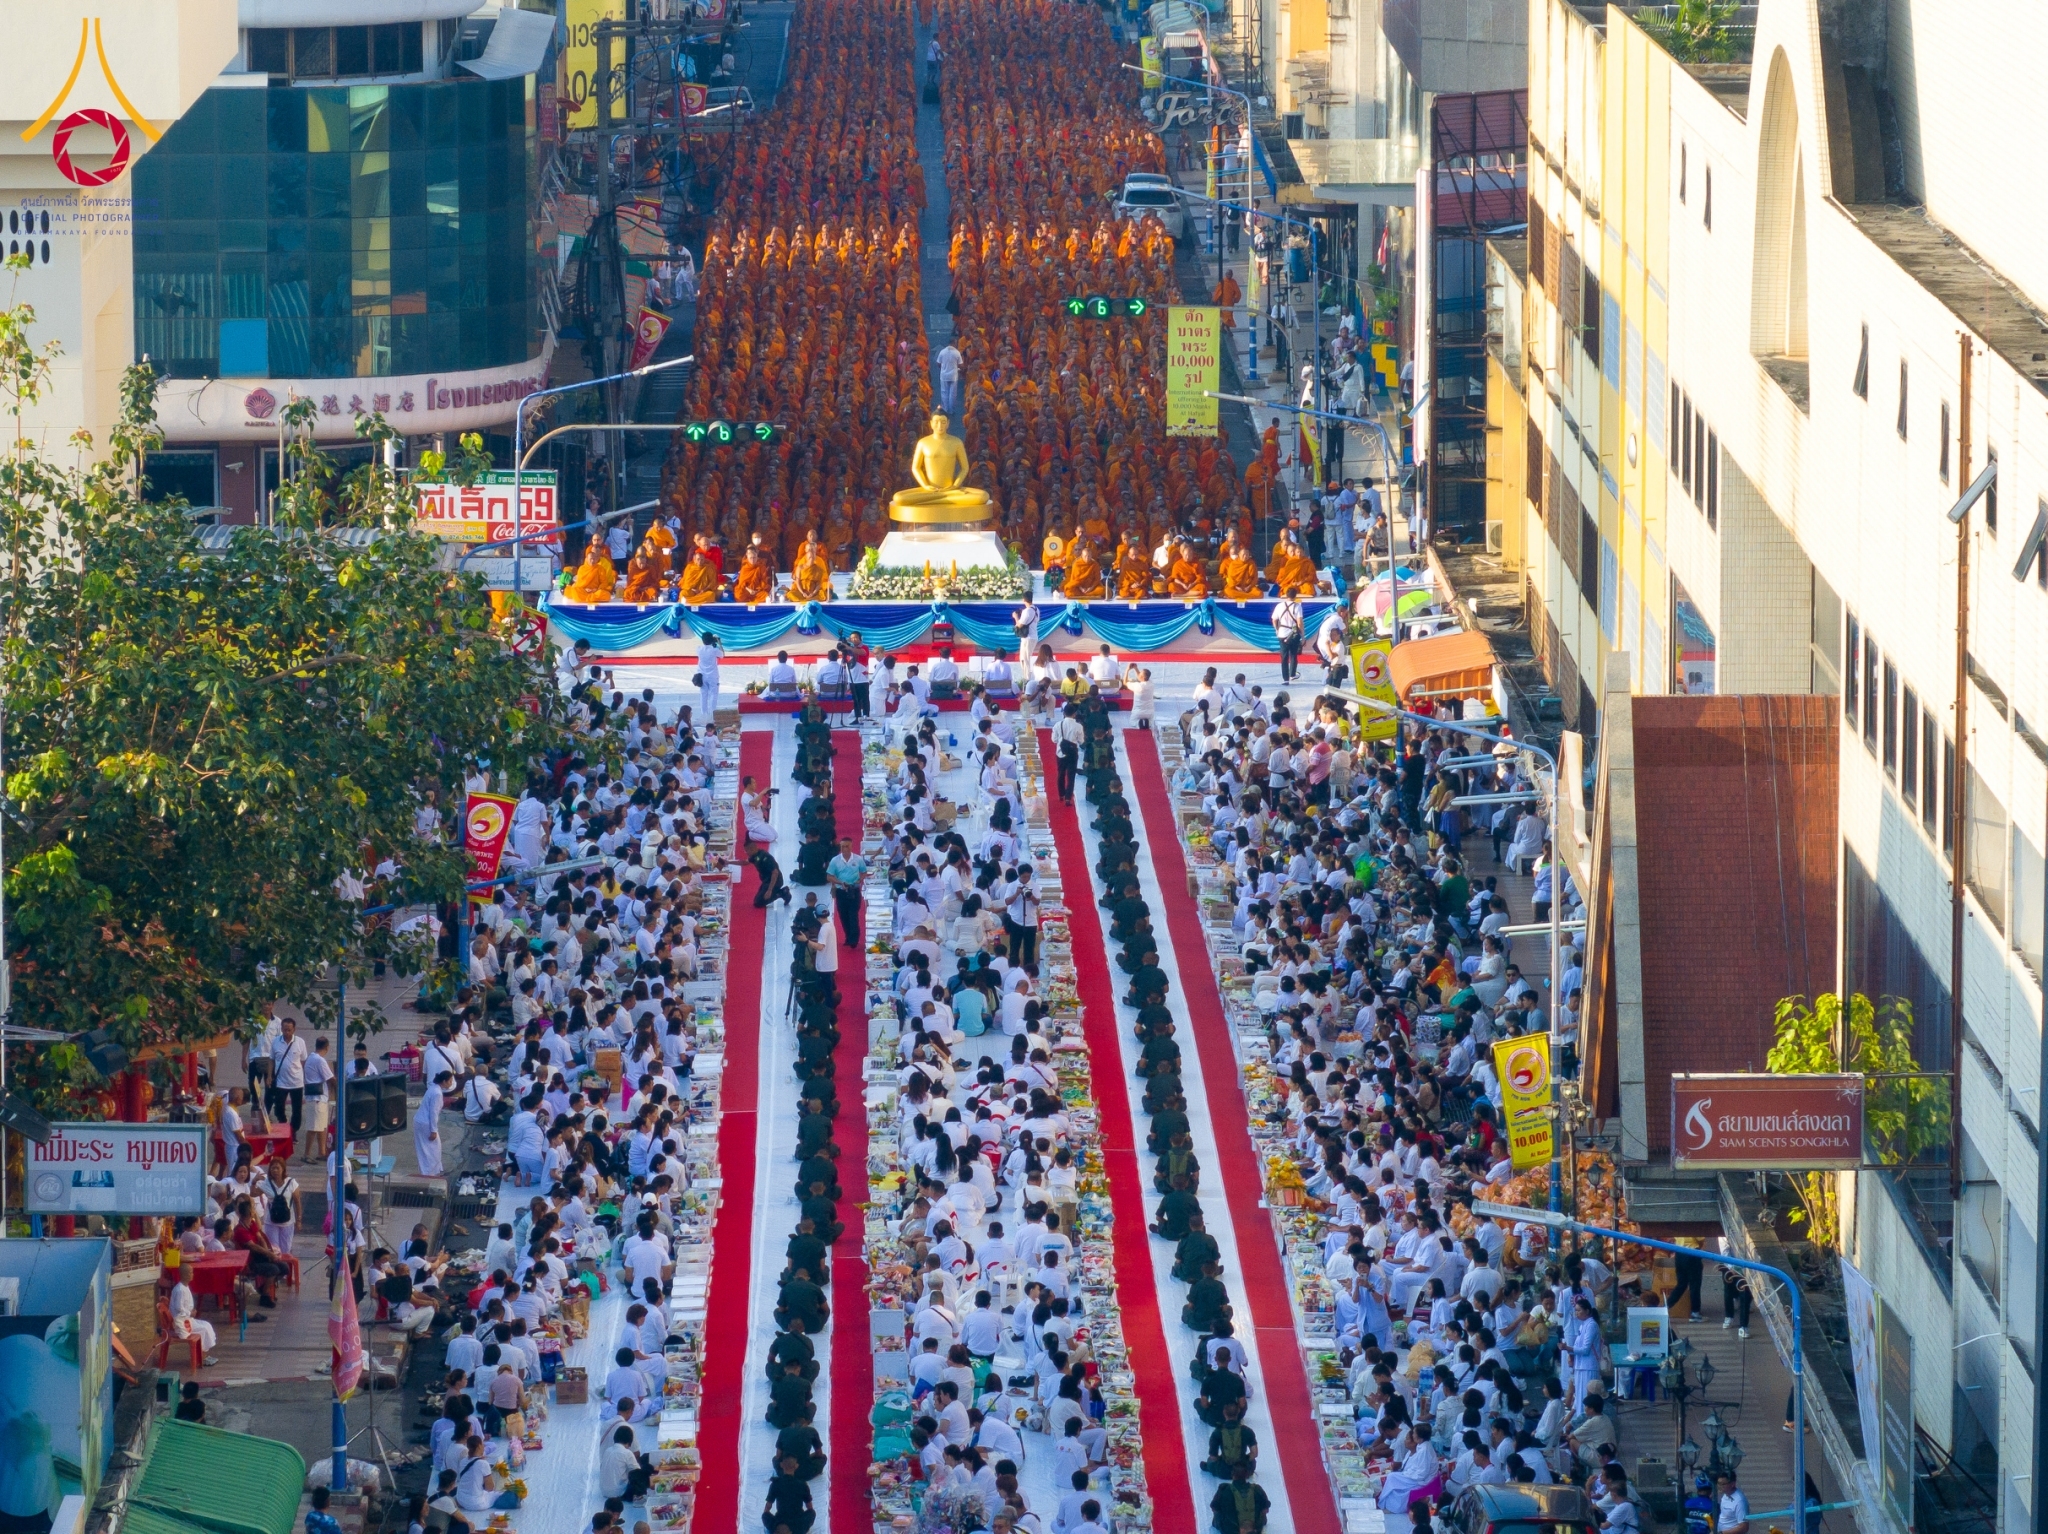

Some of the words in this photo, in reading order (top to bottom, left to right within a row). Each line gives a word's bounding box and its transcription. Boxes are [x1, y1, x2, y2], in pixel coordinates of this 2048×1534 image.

[1097, 300, 1107, 315] 6
[1184, 308, 1204, 323] ตัก
[1177, 327, 1212, 337] บาตร
[1181, 342, 1208, 353] พระ
[1170, 354, 1215, 370] 10,000
[1184, 370, 1203, 389] รูป
[292, 391, 416, 415] 花大酒店
[492, 522, 549, 542] CocaCola
[1717, 1109, 1851, 1132] สยามเซนส์สงขลา
[1514, 1130, 1549, 1148] 10,000
[1719, 1137, 1746, 1148] SIAM
[1748, 1137, 1787, 1148] SCENTS
[1789, 1136, 1850, 1147] SONGKHLA
[33, 1129, 114, 1162] หมี่มะระ
[126, 1139, 198, 1171] หมูแดง
